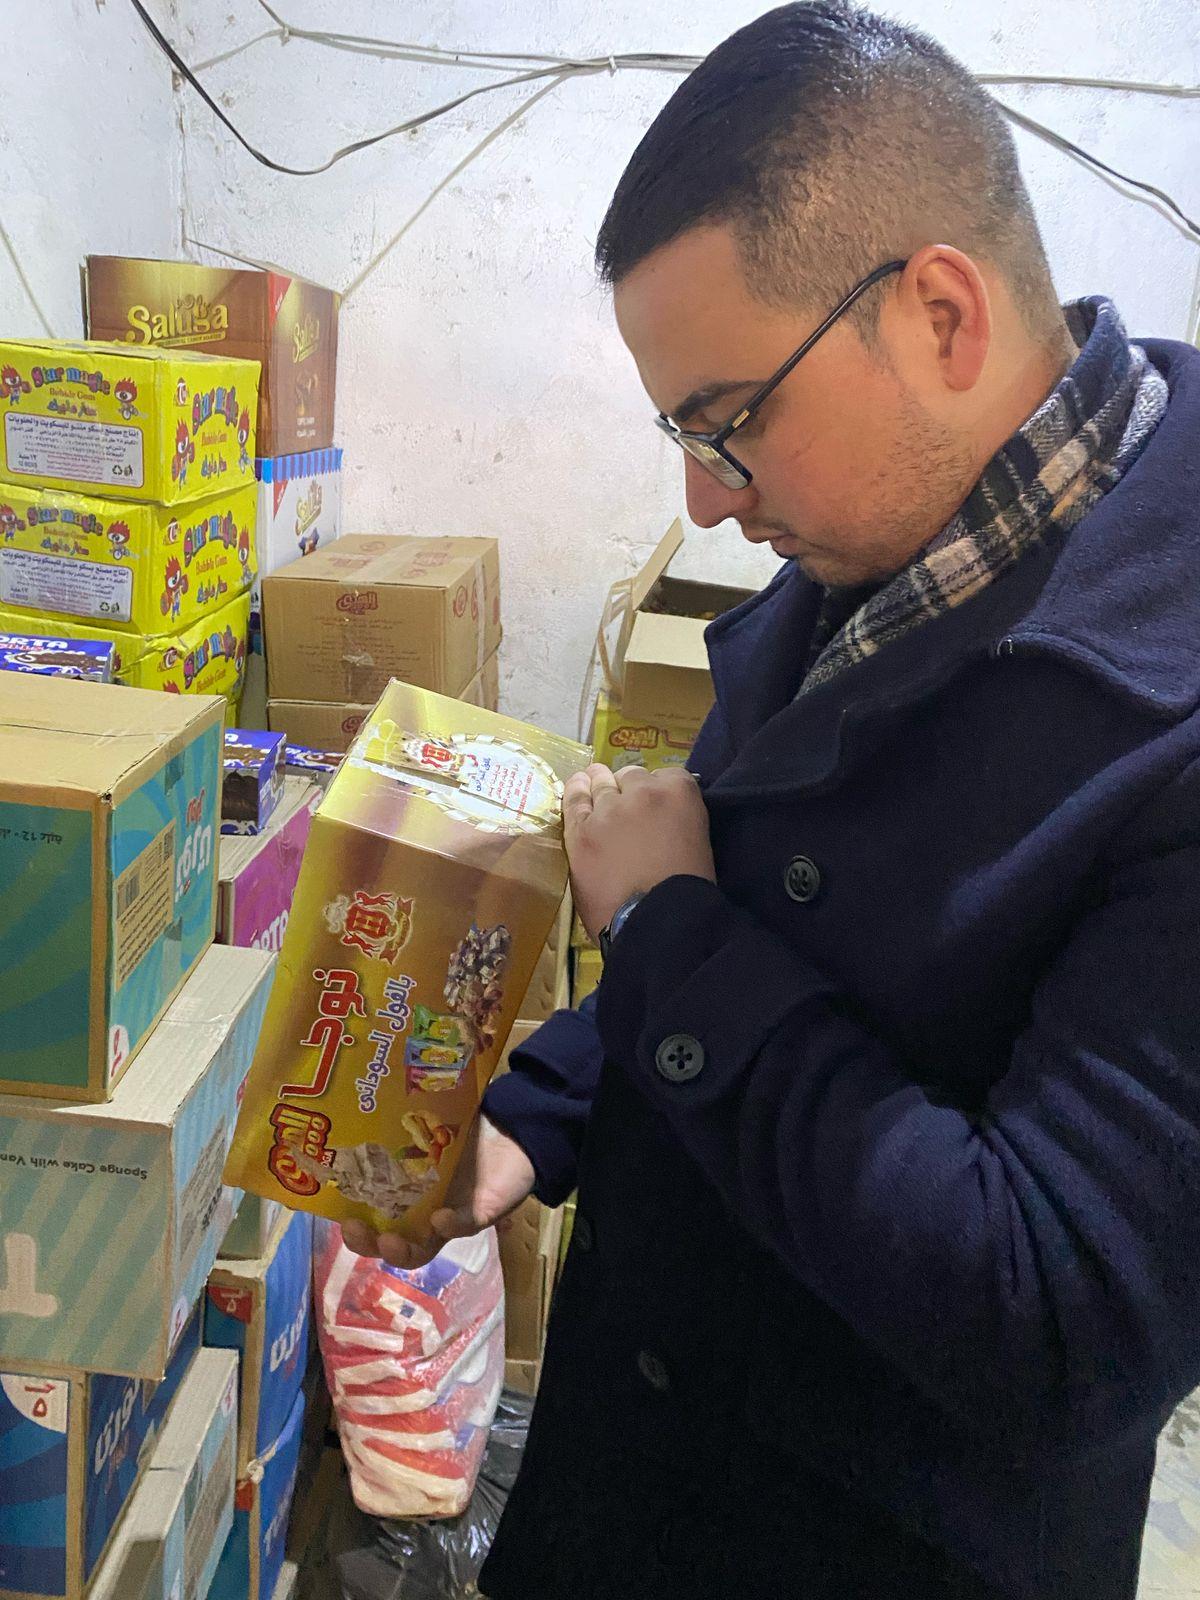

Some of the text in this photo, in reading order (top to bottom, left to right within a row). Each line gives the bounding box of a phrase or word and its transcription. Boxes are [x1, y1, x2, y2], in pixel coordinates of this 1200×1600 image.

[126, 294, 229, 345] Saluga
[377, 975, 418, 1033] بالفول
[278, 968, 367, 1101] نوجا
[30, 1155, 59, 1168] with
[63, 1159, 95, 1173] Cake
[100, 1164, 148, 1180] Sponge
